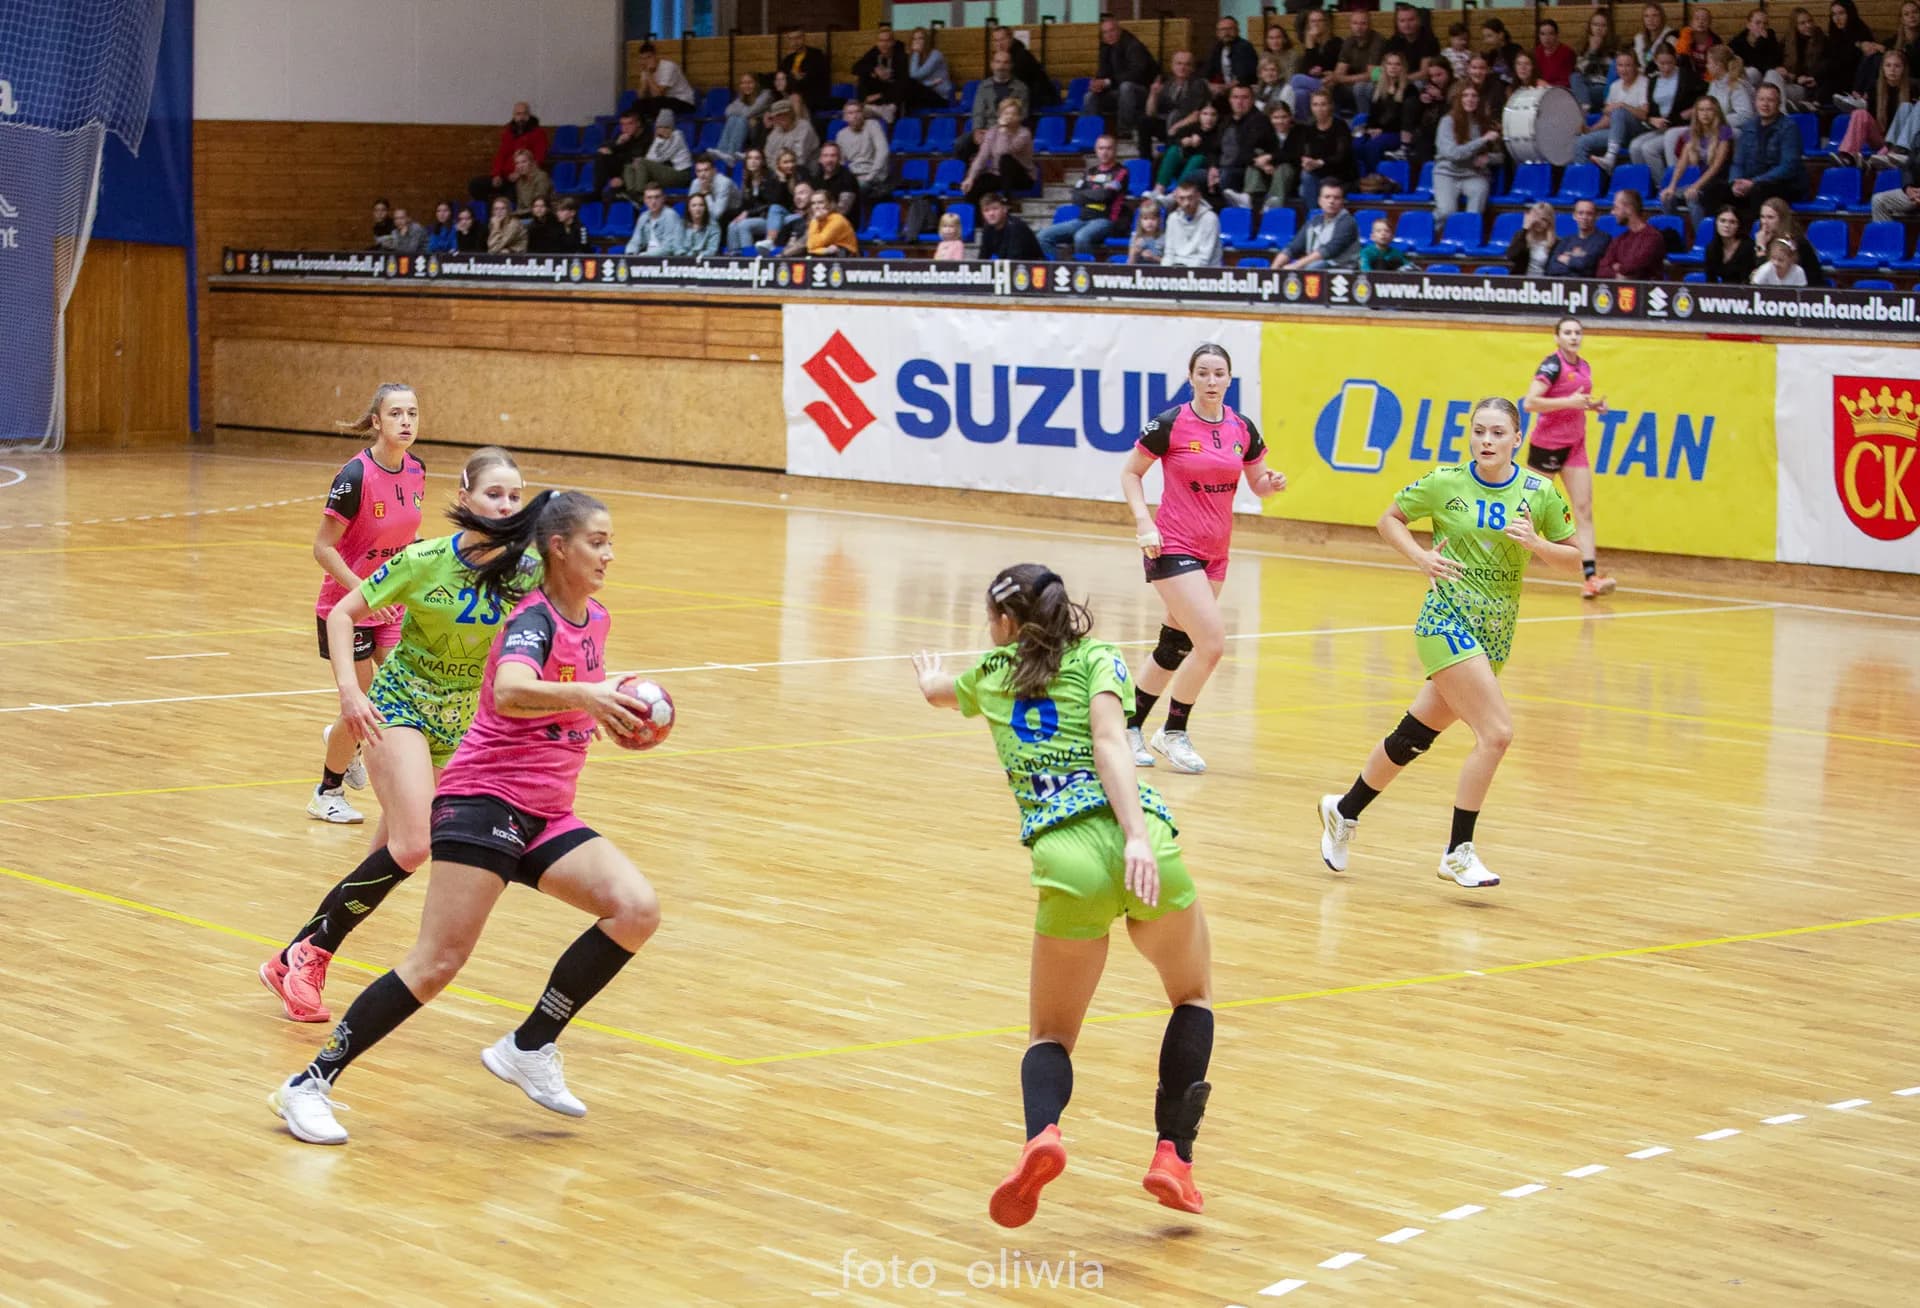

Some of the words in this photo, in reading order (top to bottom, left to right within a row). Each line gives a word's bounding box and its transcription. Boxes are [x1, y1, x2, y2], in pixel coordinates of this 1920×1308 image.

[442, 256, 568, 282] www.koronahandball.pl
[630, 260, 774, 286] www.koronahandball.pl
[1092, 269, 1280, 300] www.koronahandball.pl
[1375, 278, 1588, 313] www.koronahandball.pl
[1409, 398, 1715, 482] LETAN
[395, 484, 405, 506] 4
[1843, 440, 1917, 522] CK
[1475, 499, 1506, 530] 18
[456, 587, 500, 625] 23
[1443, 630, 1476, 656] 18
[417, 655, 483, 679] MAREC
